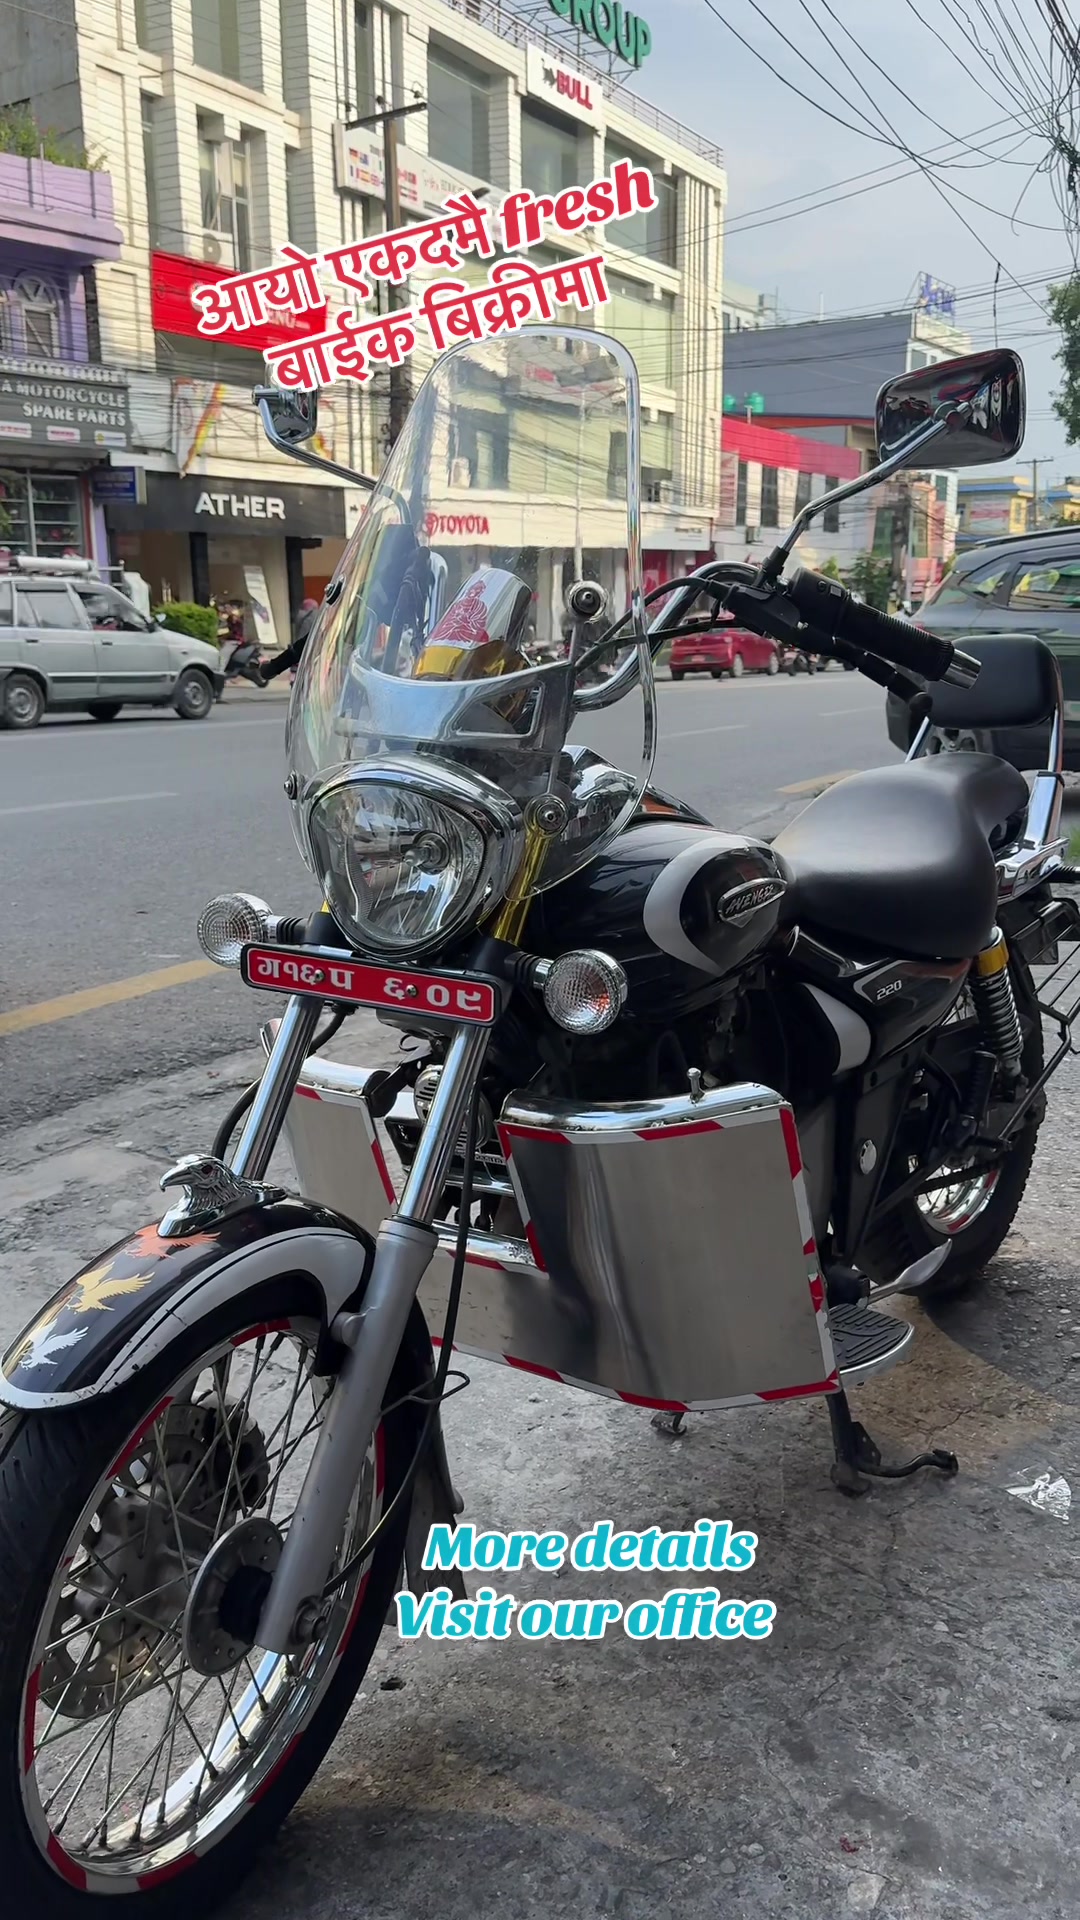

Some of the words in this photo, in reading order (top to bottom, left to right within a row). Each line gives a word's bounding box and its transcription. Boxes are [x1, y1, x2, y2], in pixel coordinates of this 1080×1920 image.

[547, 0, 652, 68] ROUP
[556, 69, 593, 111] BULL
[16, 380, 126, 408] MOTORCYCLE
[22, 402, 75, 421] SPARE
[77, 408, 126, 427] PARTS
[194, 491, 286, 520] ATHER
[438, 515, 490, 535] TOYOTA
[876, 979, 903, 1001] 220
